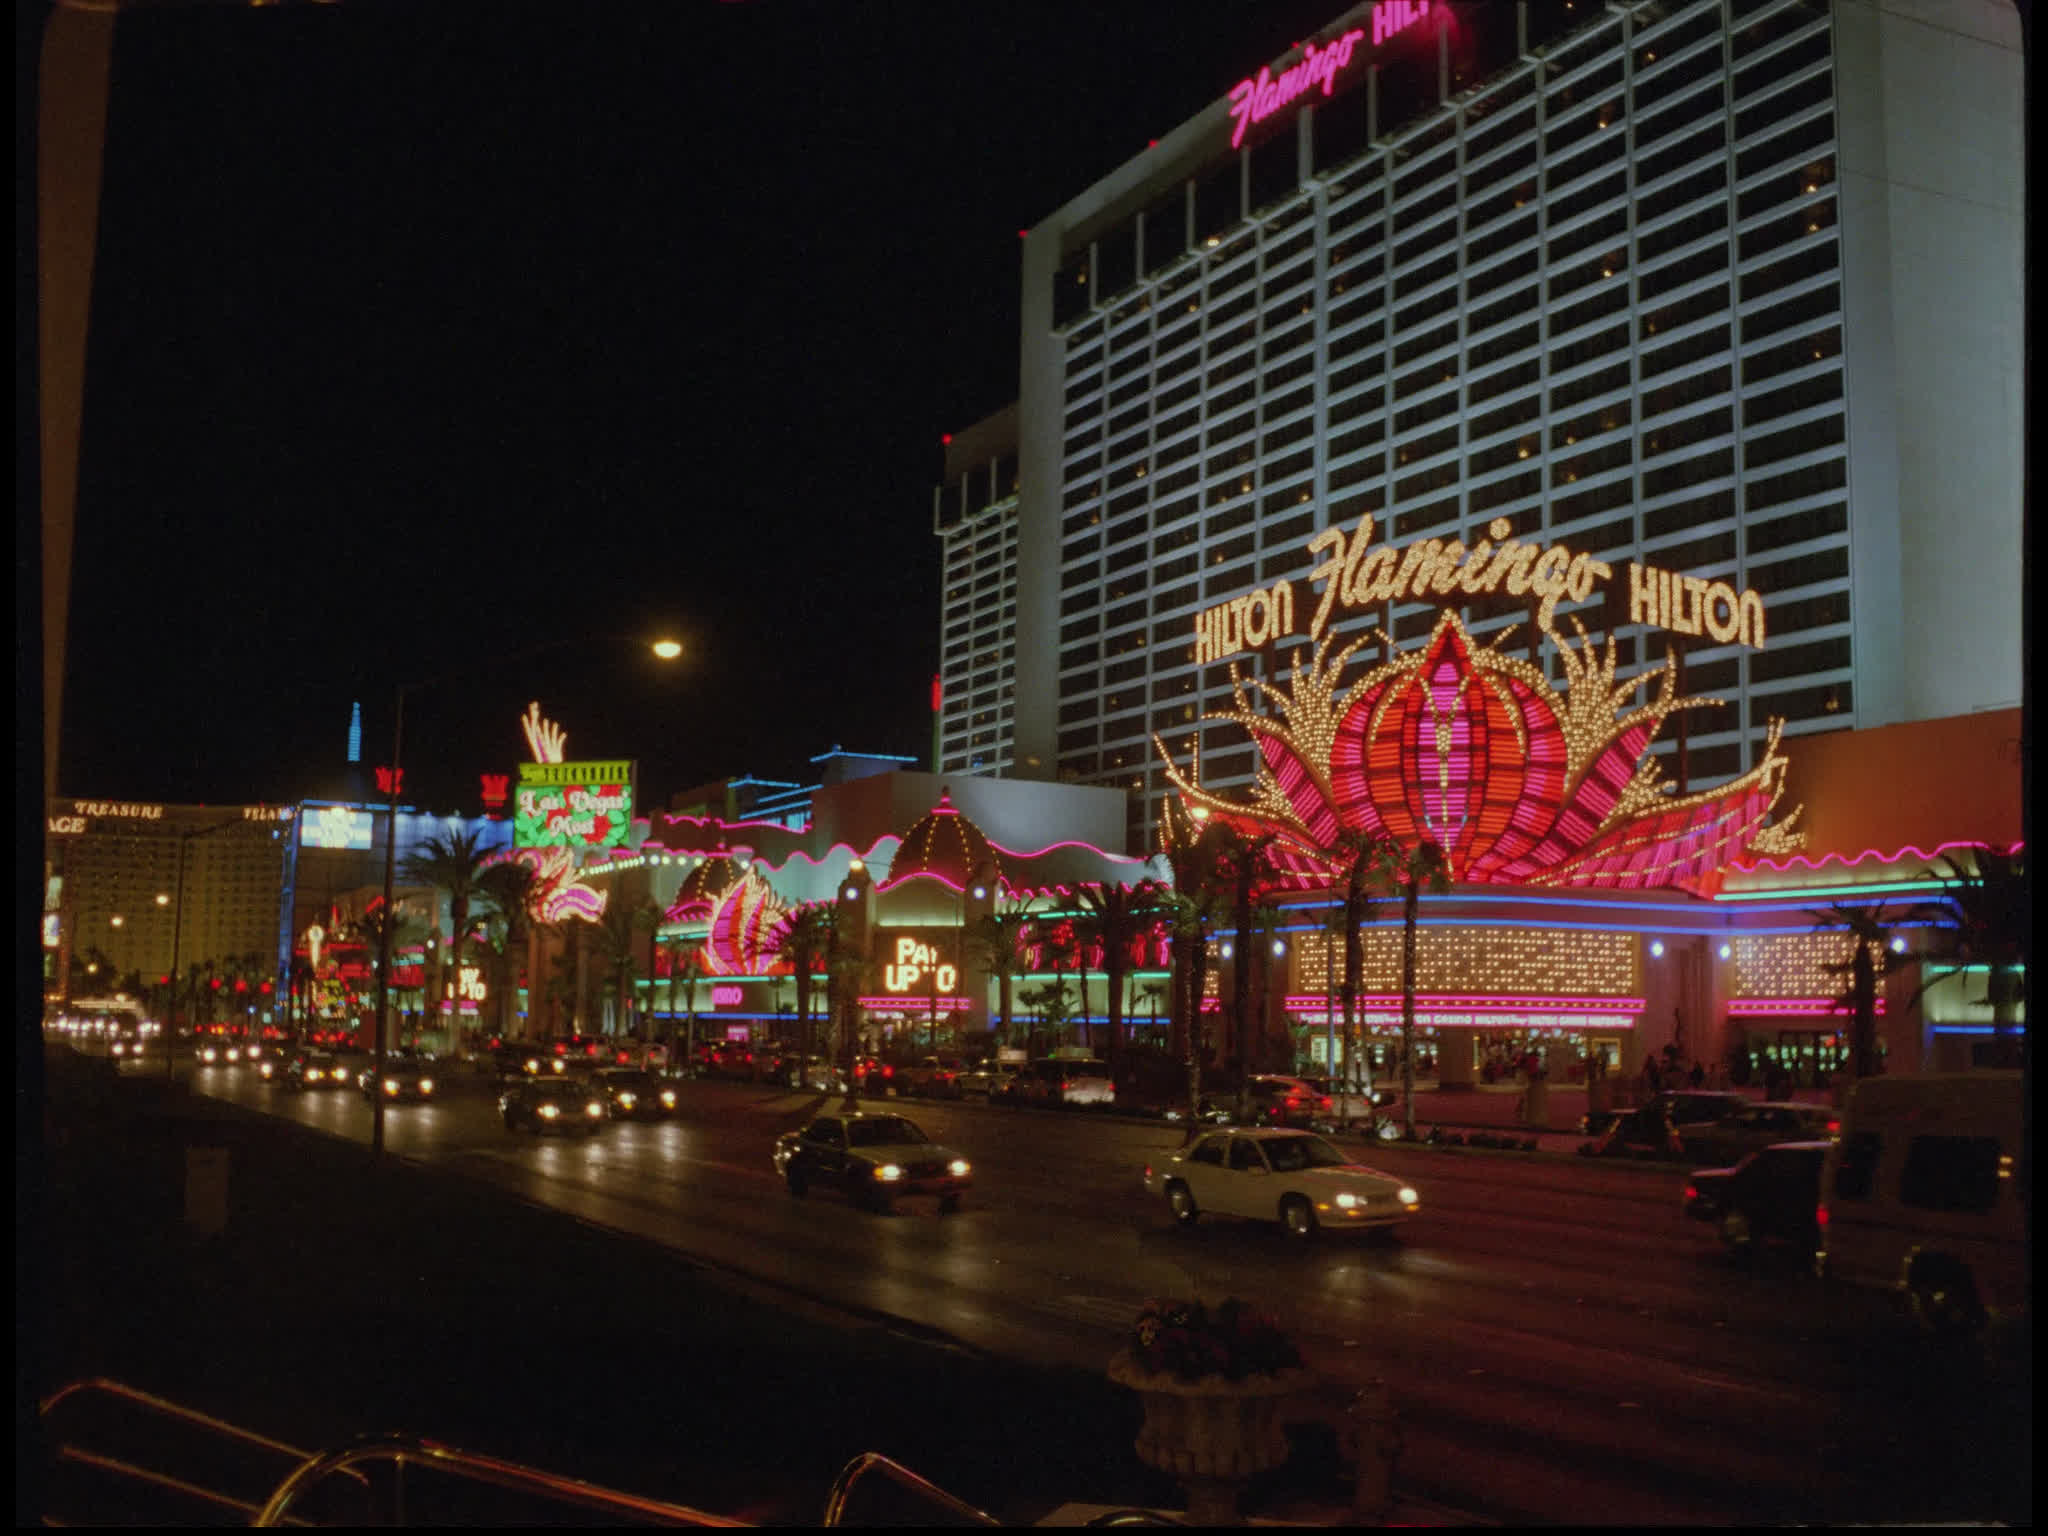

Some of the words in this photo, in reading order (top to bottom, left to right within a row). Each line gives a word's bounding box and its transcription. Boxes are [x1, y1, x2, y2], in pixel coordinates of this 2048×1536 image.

[1228, 29, 1364, 149] Flamingo
[1195, 579, 1294, 666] HILTON
[1307, 512, 1613, 642] Flamingo
[1629, 563, 1767, 649] HILTON
[74, 801, 163, 820] TREASURE
[885, 964, 920, 992] UP
